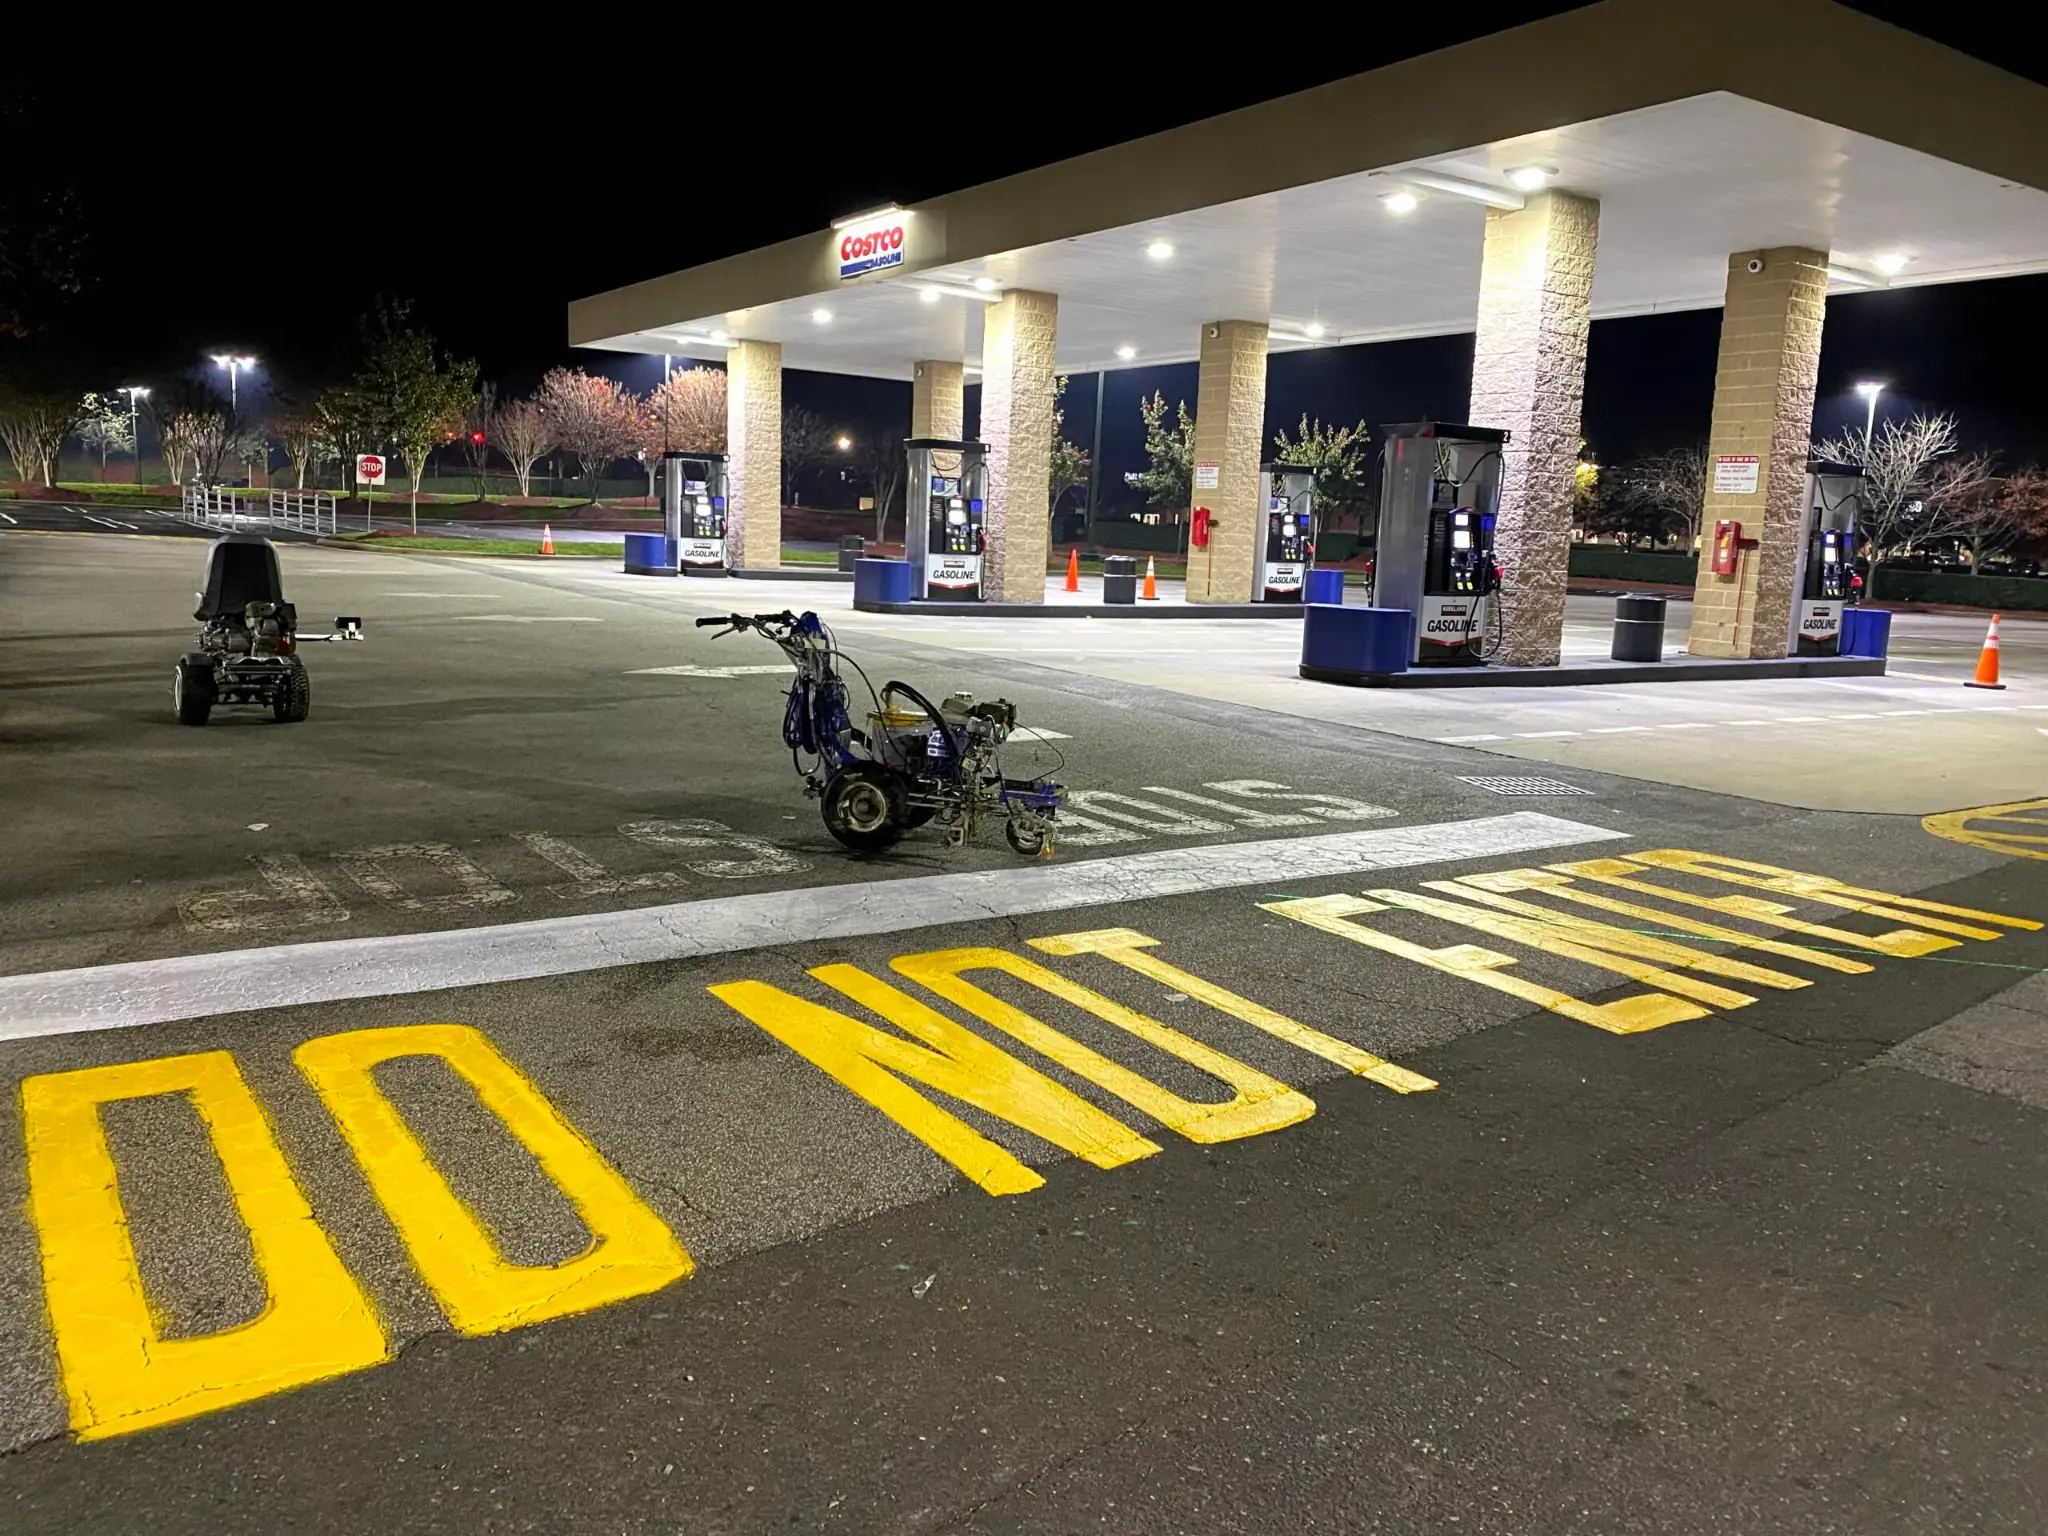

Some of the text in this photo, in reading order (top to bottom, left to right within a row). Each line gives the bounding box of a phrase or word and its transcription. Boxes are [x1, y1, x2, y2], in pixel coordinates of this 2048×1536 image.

[841, 226, 903, 261] COSTCO
[1503, 431, 1509, 441] 2
[361, 462, 382, 472] STOP
[933, 570, 976, 579] GASOLINE
[1268, 576, 1300, 584] GASOLINE
[1427, 620, 1478, 632] GASOLINE
[1803, 619, 1837, 629] GASOLINE
[20, 849, 2046, 1443] DO NOT ENTER
